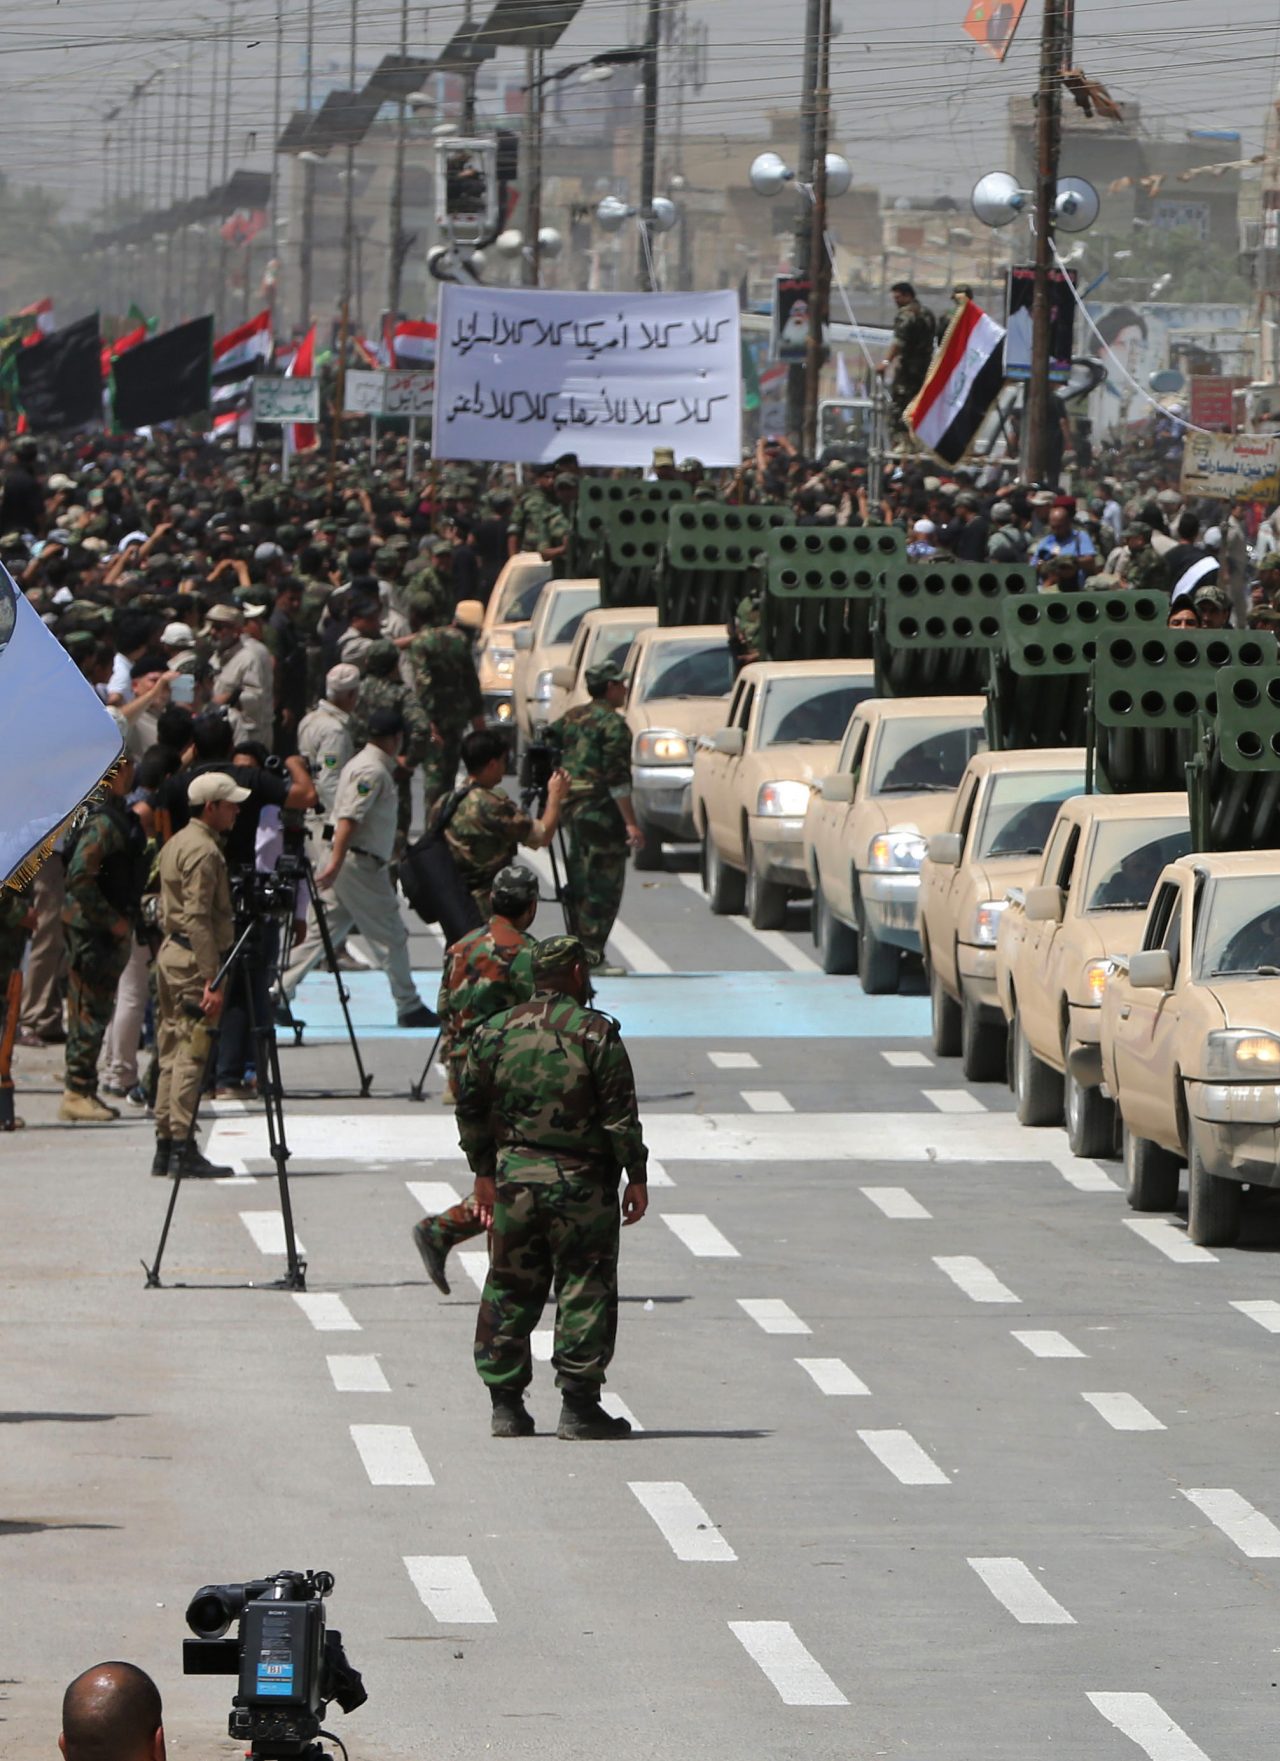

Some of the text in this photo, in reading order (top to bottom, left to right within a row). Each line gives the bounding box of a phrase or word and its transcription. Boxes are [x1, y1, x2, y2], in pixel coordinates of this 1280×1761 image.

[640, 322, 684, 350] كلا
[688, 318, 731, 344] كلا
[630, 397, 677, 425] كلا
[675, 394, 729, 425] كلا
